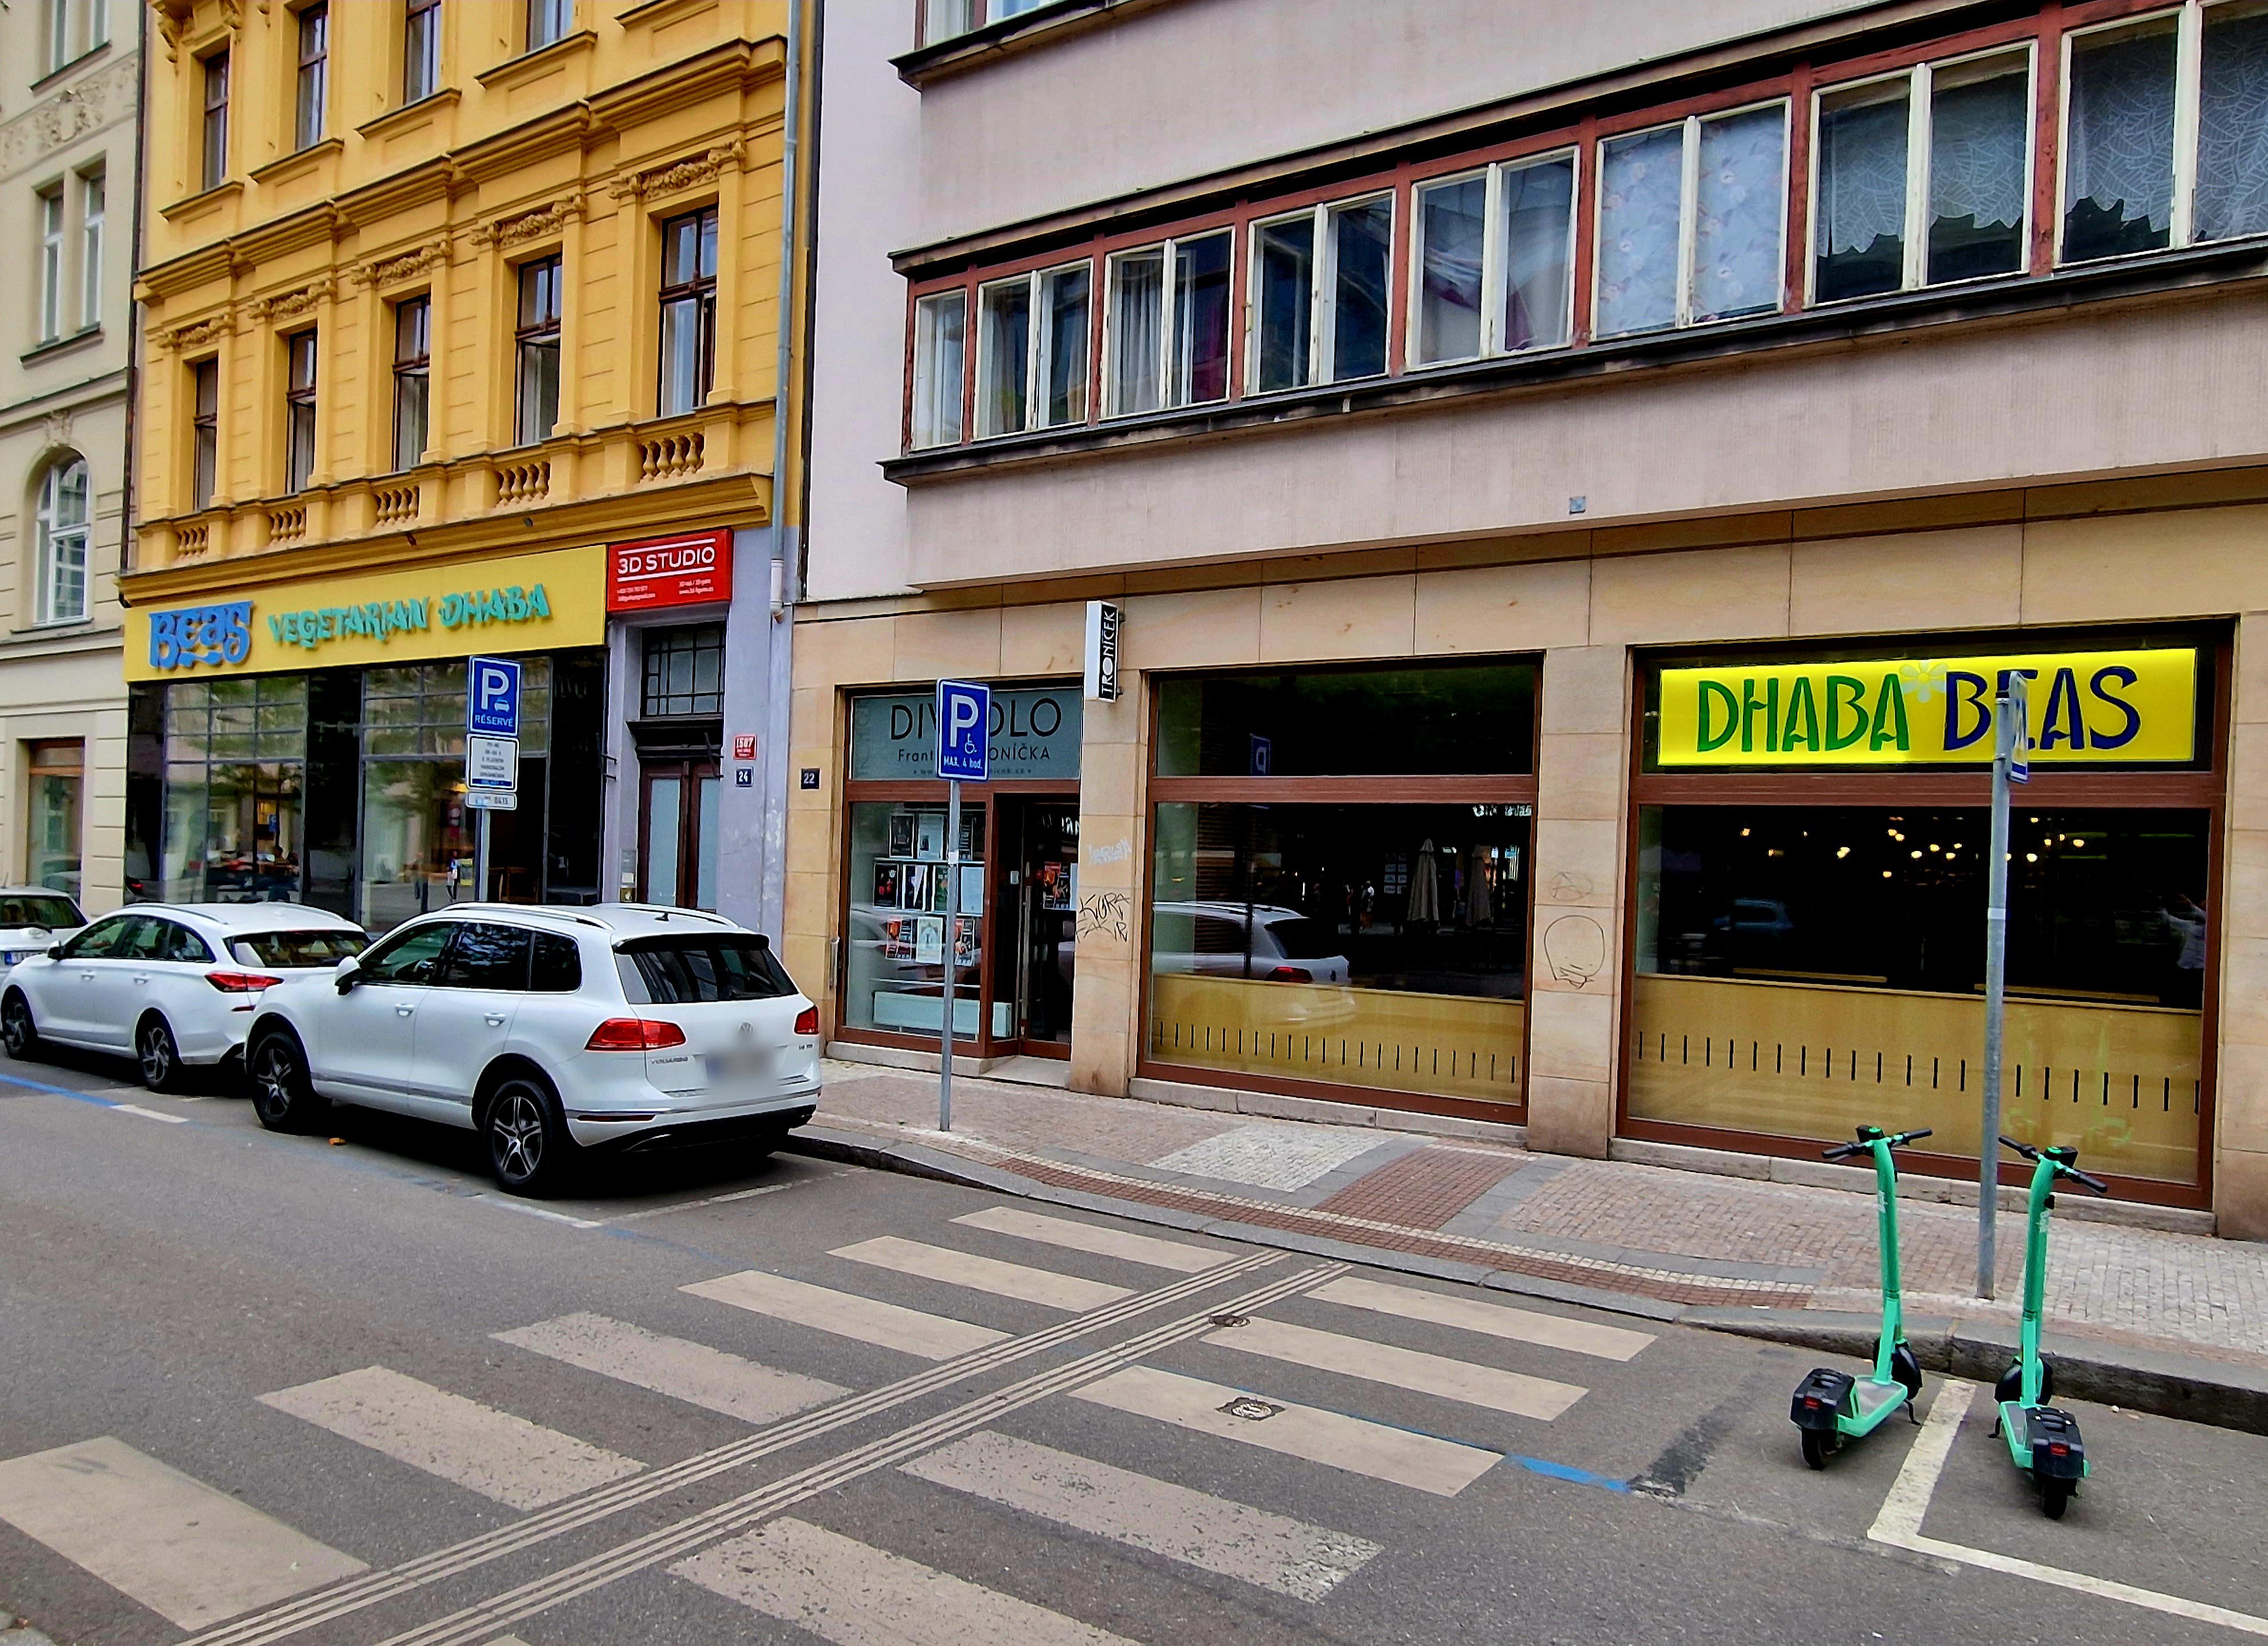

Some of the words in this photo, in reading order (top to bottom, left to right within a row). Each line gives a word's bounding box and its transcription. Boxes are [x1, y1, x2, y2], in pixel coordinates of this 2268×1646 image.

[617, 557, 641, 574] 3D
[645, 546, 715, 571] STUDIO
[267, 596, 430, 648] VEGETARIAN
[439, 584, 550, 627] DHABA
[481, 668, 509, 710] P
[950, 694, 978, 747] P
[1697, 673, 1910, 753] DHABA
[739, 770, 748, 782] 24
[804, 773, 814, 784] 22
